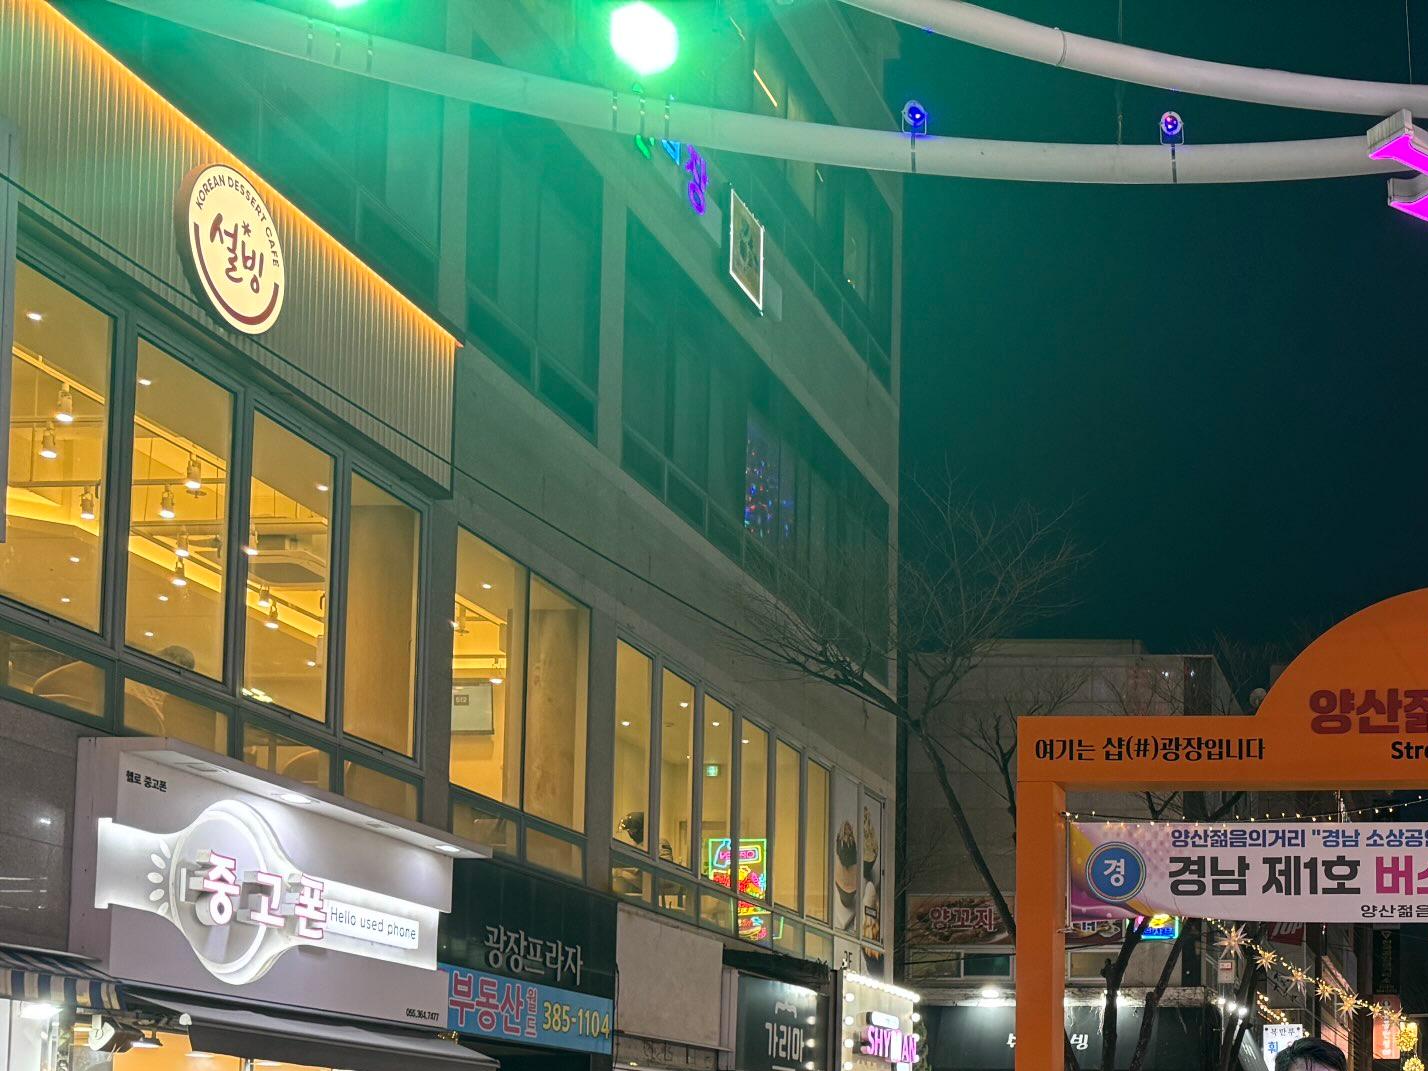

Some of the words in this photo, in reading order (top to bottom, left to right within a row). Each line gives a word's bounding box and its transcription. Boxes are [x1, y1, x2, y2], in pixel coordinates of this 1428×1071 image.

[195, 174, 226, 211] KOREAN
[227, 175, 267, 223] DESSERT
[265, 227, 280, 267] CAFE
[209, 212, 265, 294] 설빙
[1035, 738, 1096, 761] 여기는
[1102, 735, 1266, 761] 샵(#)광장입니다
[143, 775, 168, 793] 중고폰
[1171, 828, 1306, 848] 양산젊음의거리
[1103, 858, 1126, 887] 경
[1168, 855, 1250, 897] 경남
[1262, 855, 1361, 896] 제1호
[200, 849, 328, 940] 중고폰
[329, 904, 357, 927] Hello
[360, 914, 385, 934] used
[387, 921, 417, 941] phone
[484, 924, 584, 986] 광장프라자
[449, 971, 525, 1037] 부동산
[542, 1000, 611, 1040] 385-1104
